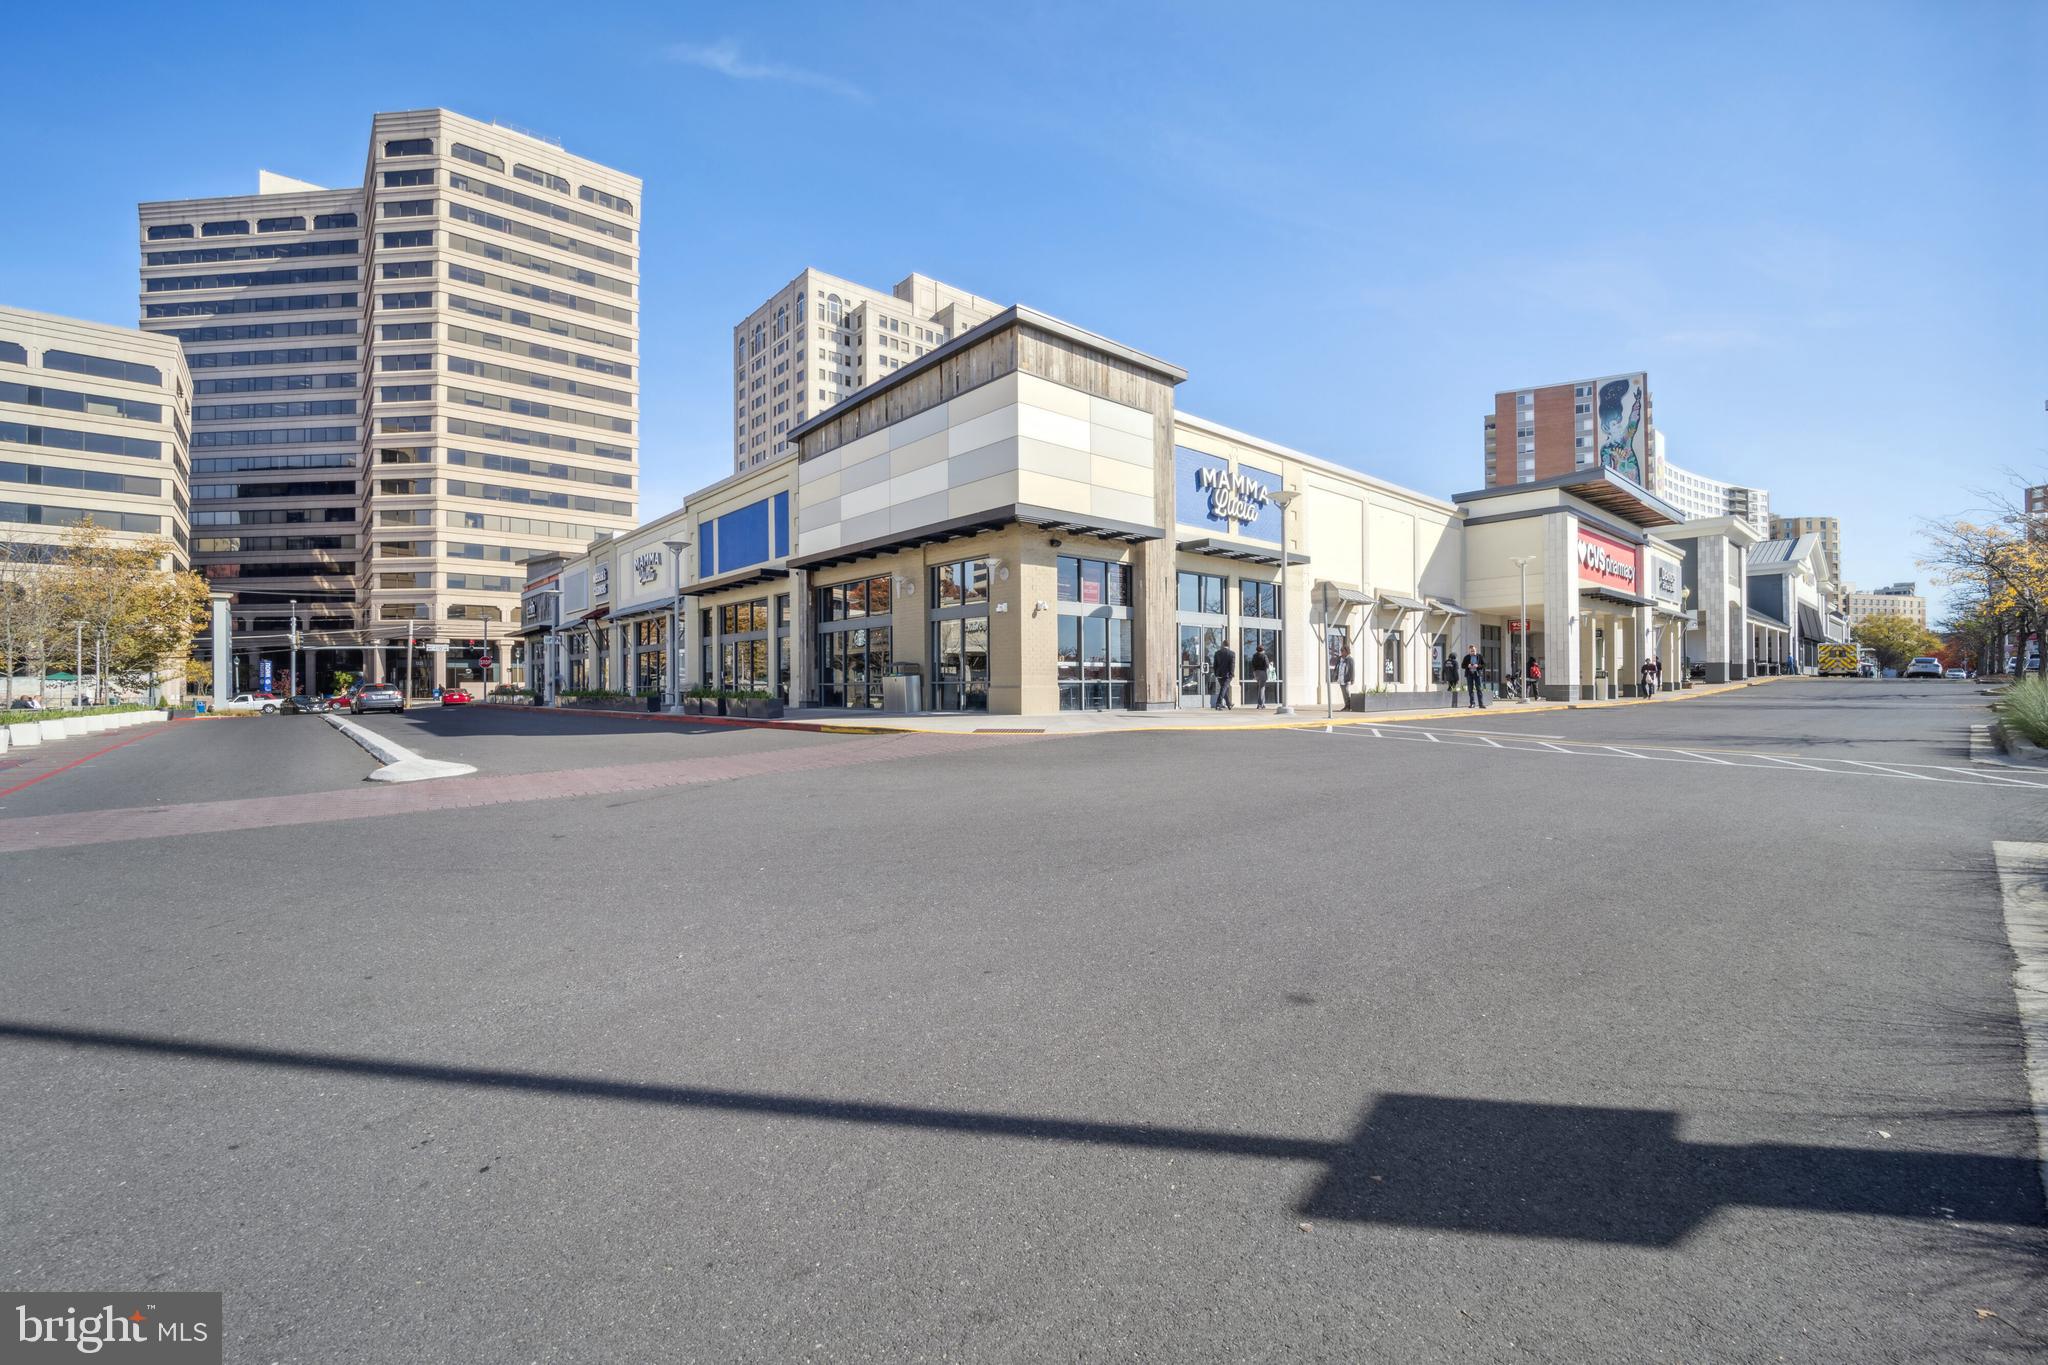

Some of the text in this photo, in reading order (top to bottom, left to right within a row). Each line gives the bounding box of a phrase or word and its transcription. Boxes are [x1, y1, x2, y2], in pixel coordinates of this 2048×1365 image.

[1199, 467, 1269, 505] MAMMA
[1213, 488, 1258, 521] Lucia
[634, 552, 660, 571] MAMMA
[1588, 543, 1605, 571] CVS
[1606, 556, 1635, 583] pharmacy
